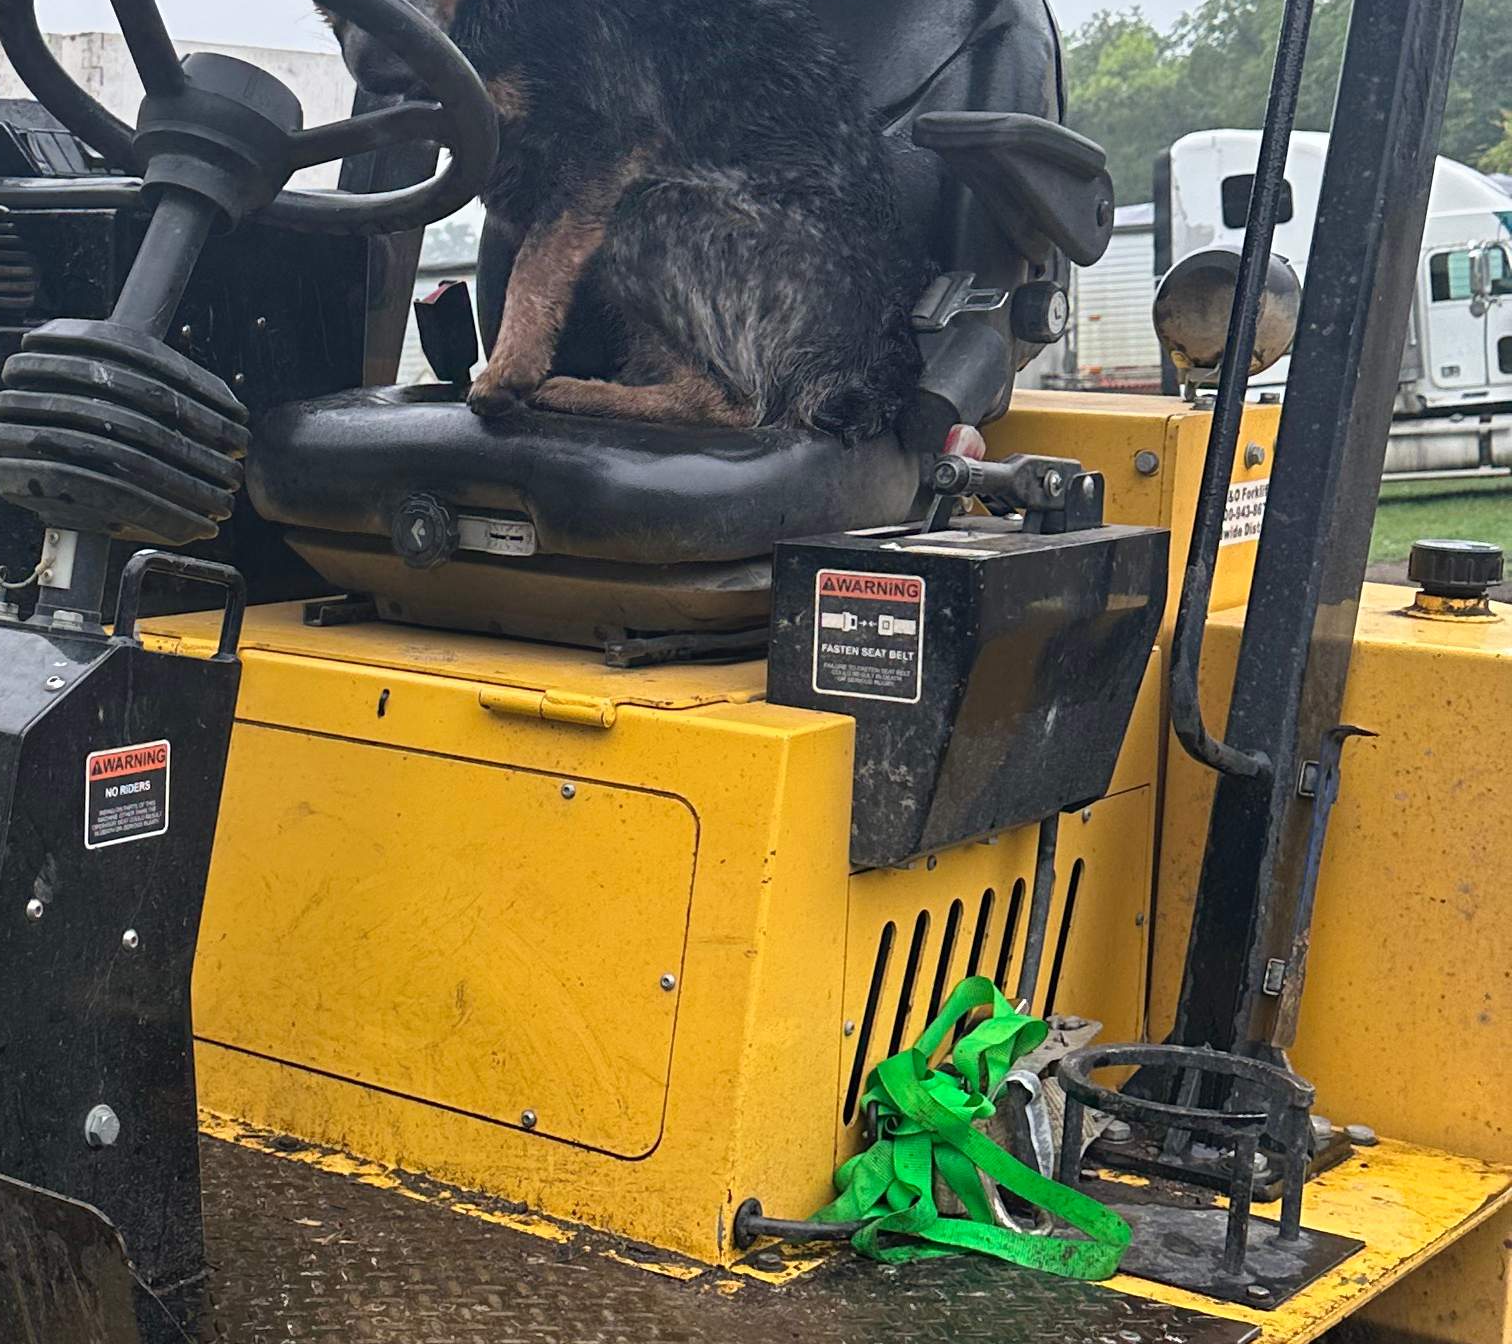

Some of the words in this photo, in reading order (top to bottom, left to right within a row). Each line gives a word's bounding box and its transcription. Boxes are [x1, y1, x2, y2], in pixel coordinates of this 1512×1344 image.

[836, 578, 919, 598] WARNING
[821, 643, 859, 656] FASTEN
[861, 647, 887, 658] SEAT
[889, 650, 914, 661] BELT
[102, 748, 166, 773] WARNING
[105, 786, 118, 798] NO
[120, 780, 151, 796] RIDERS
